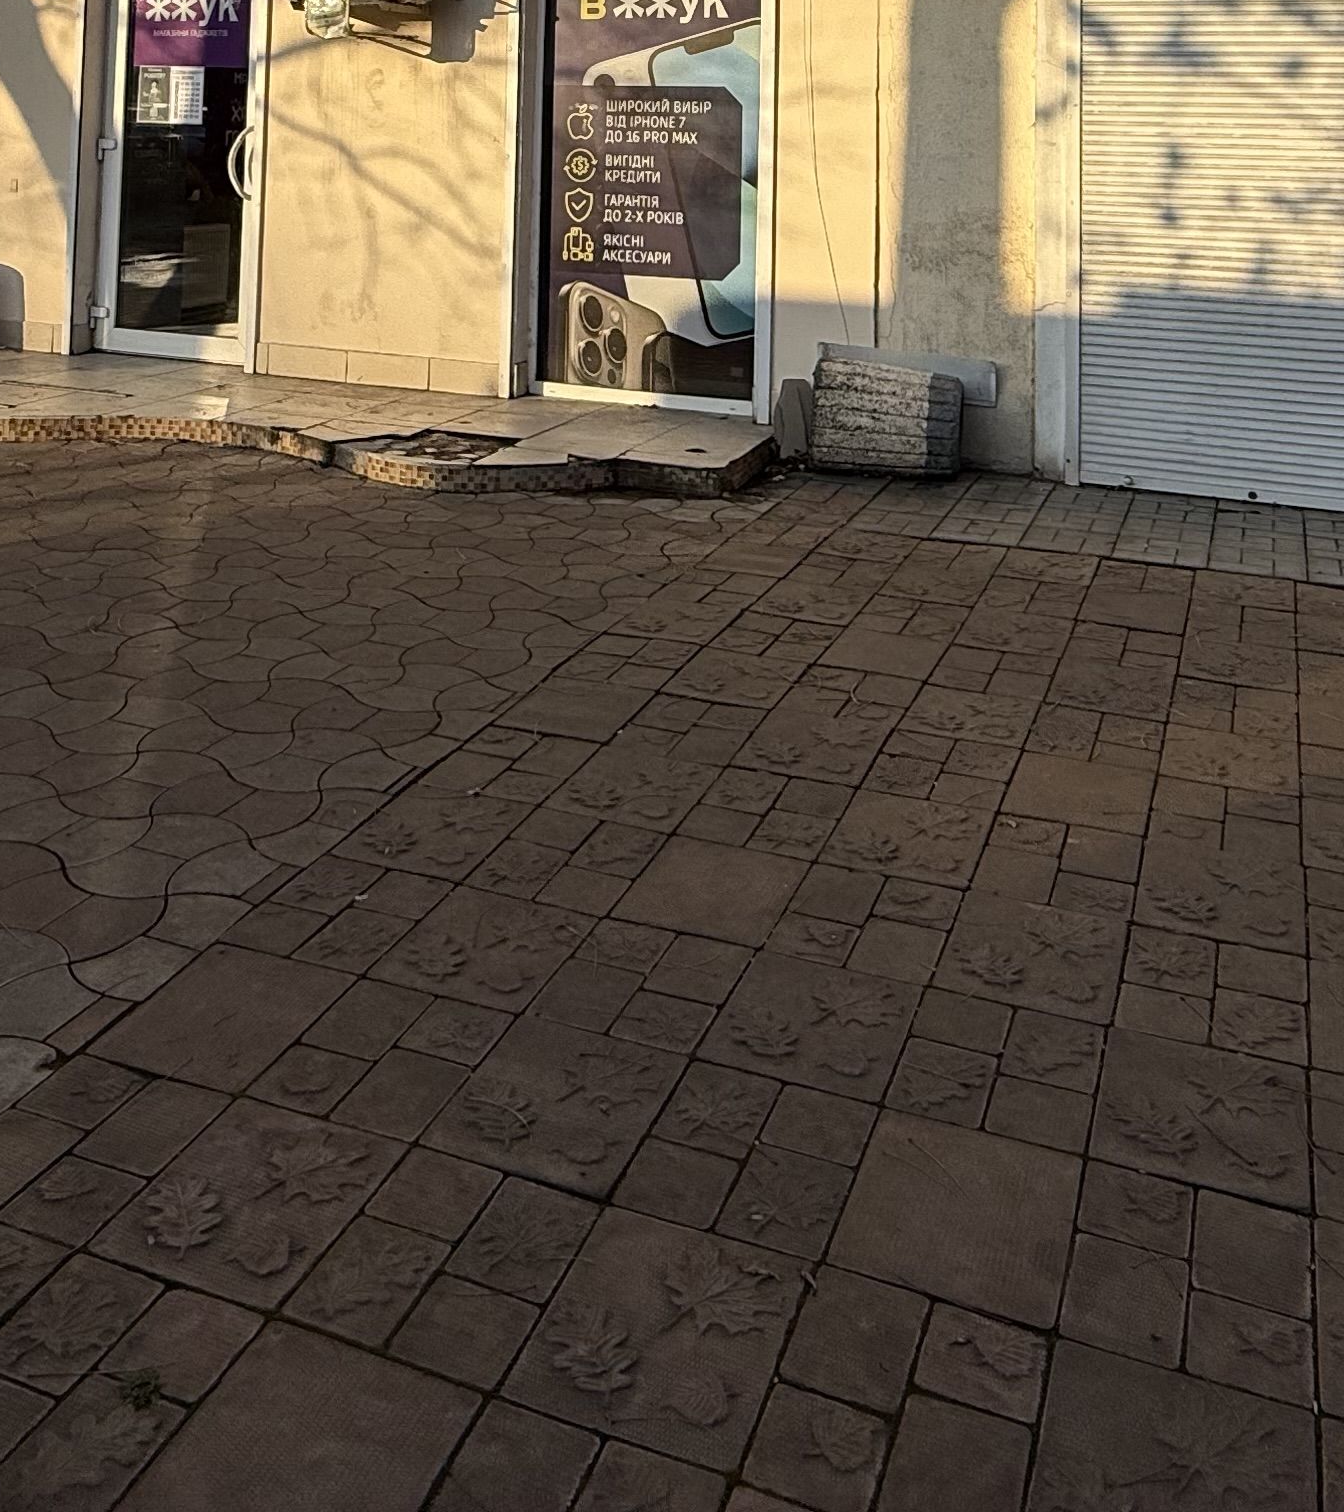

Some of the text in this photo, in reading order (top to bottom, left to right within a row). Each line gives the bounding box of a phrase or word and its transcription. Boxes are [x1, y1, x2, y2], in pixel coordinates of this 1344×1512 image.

[606, 99, 712, 114] ШИРОКИЙ ВИБІР
[606, 116, 686, 129] ВІД IPHONE 7
[605, 131, 698, 144] ДО 16 PRO MAX
[605, 154, 655, 169] ВИГІДНІ
[605, 170, 661, 184] КРЕДИТИ
[605, 194, 659, 208] ГАРАНТІЯ
[603, 209, 685, 225] ДО 2-Х РОКІВ
[603, 234, 644, 248] ЯКІСНІ
[602, 249, 671, 265] АКСЕСУАРИ
